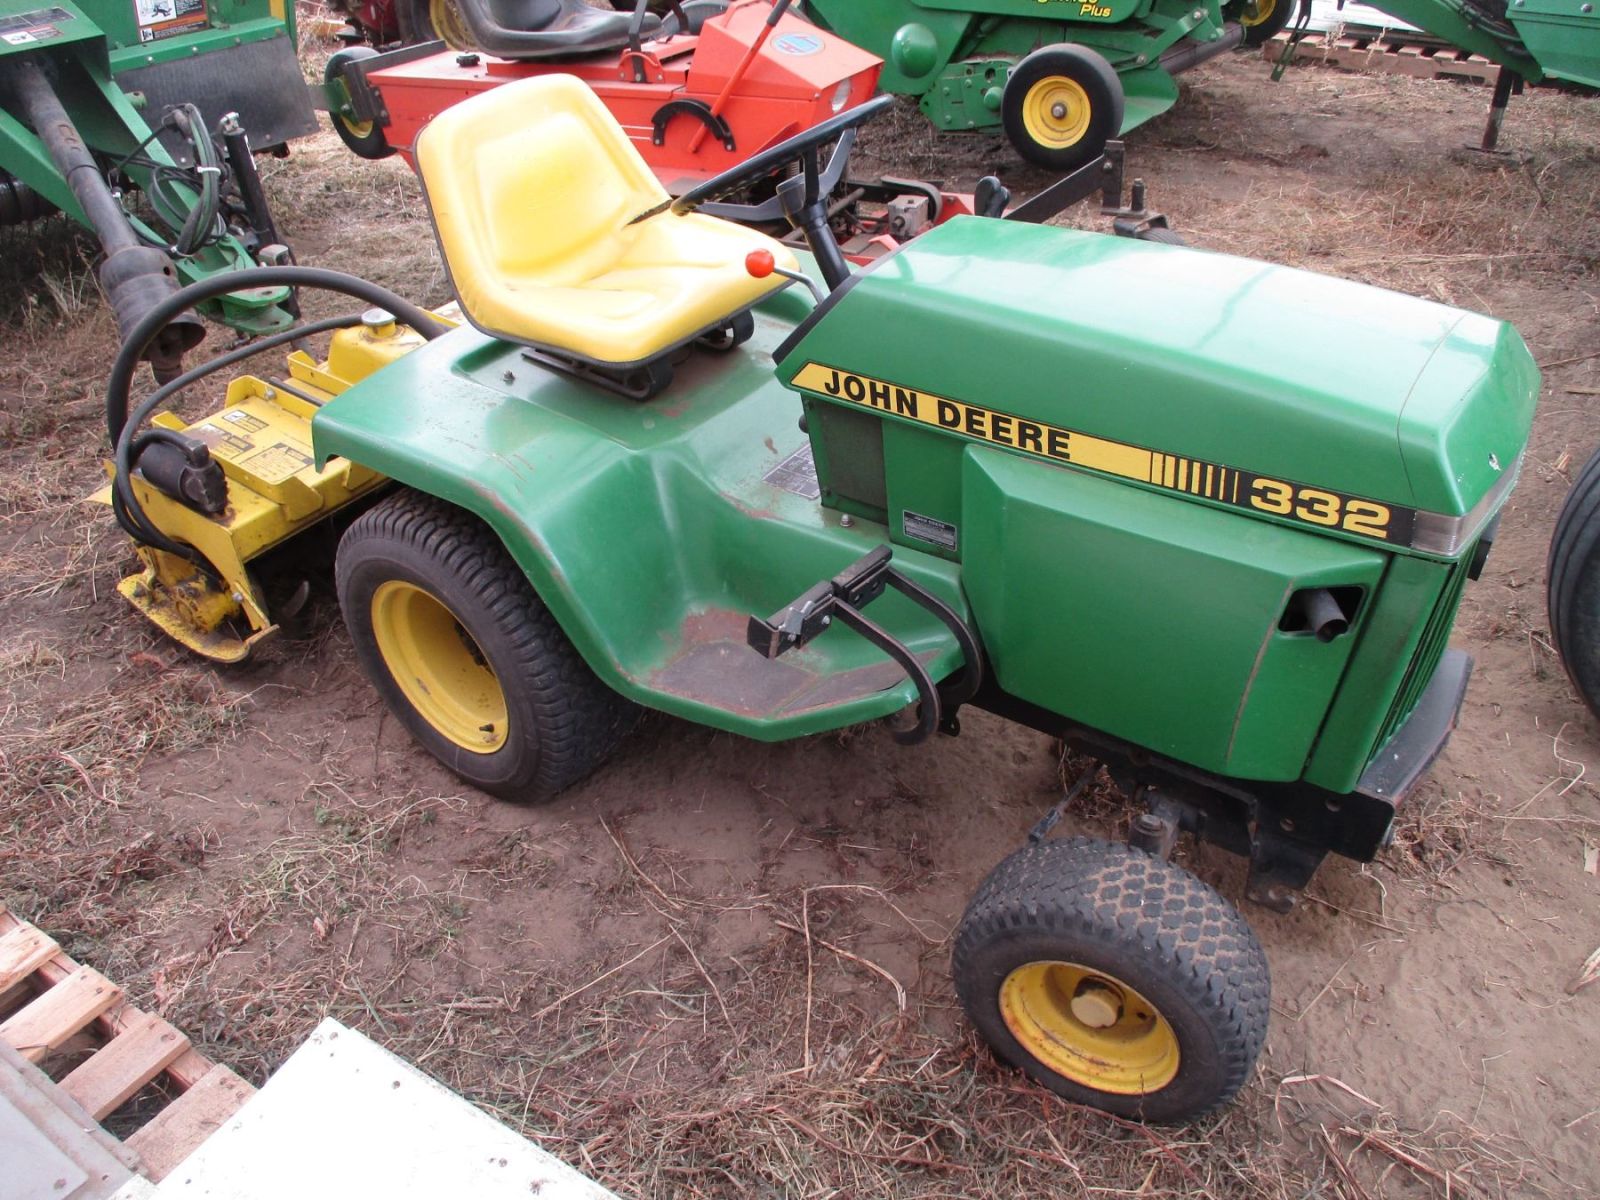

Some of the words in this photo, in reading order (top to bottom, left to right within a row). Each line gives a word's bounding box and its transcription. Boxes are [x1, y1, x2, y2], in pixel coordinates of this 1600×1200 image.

[1079, 4, 1112, 17] Plus
[825, 370, 918, 418] JOHN
[938, 400, 1071, 460] DEERE
[1250, 478, 1390, 539] 332
